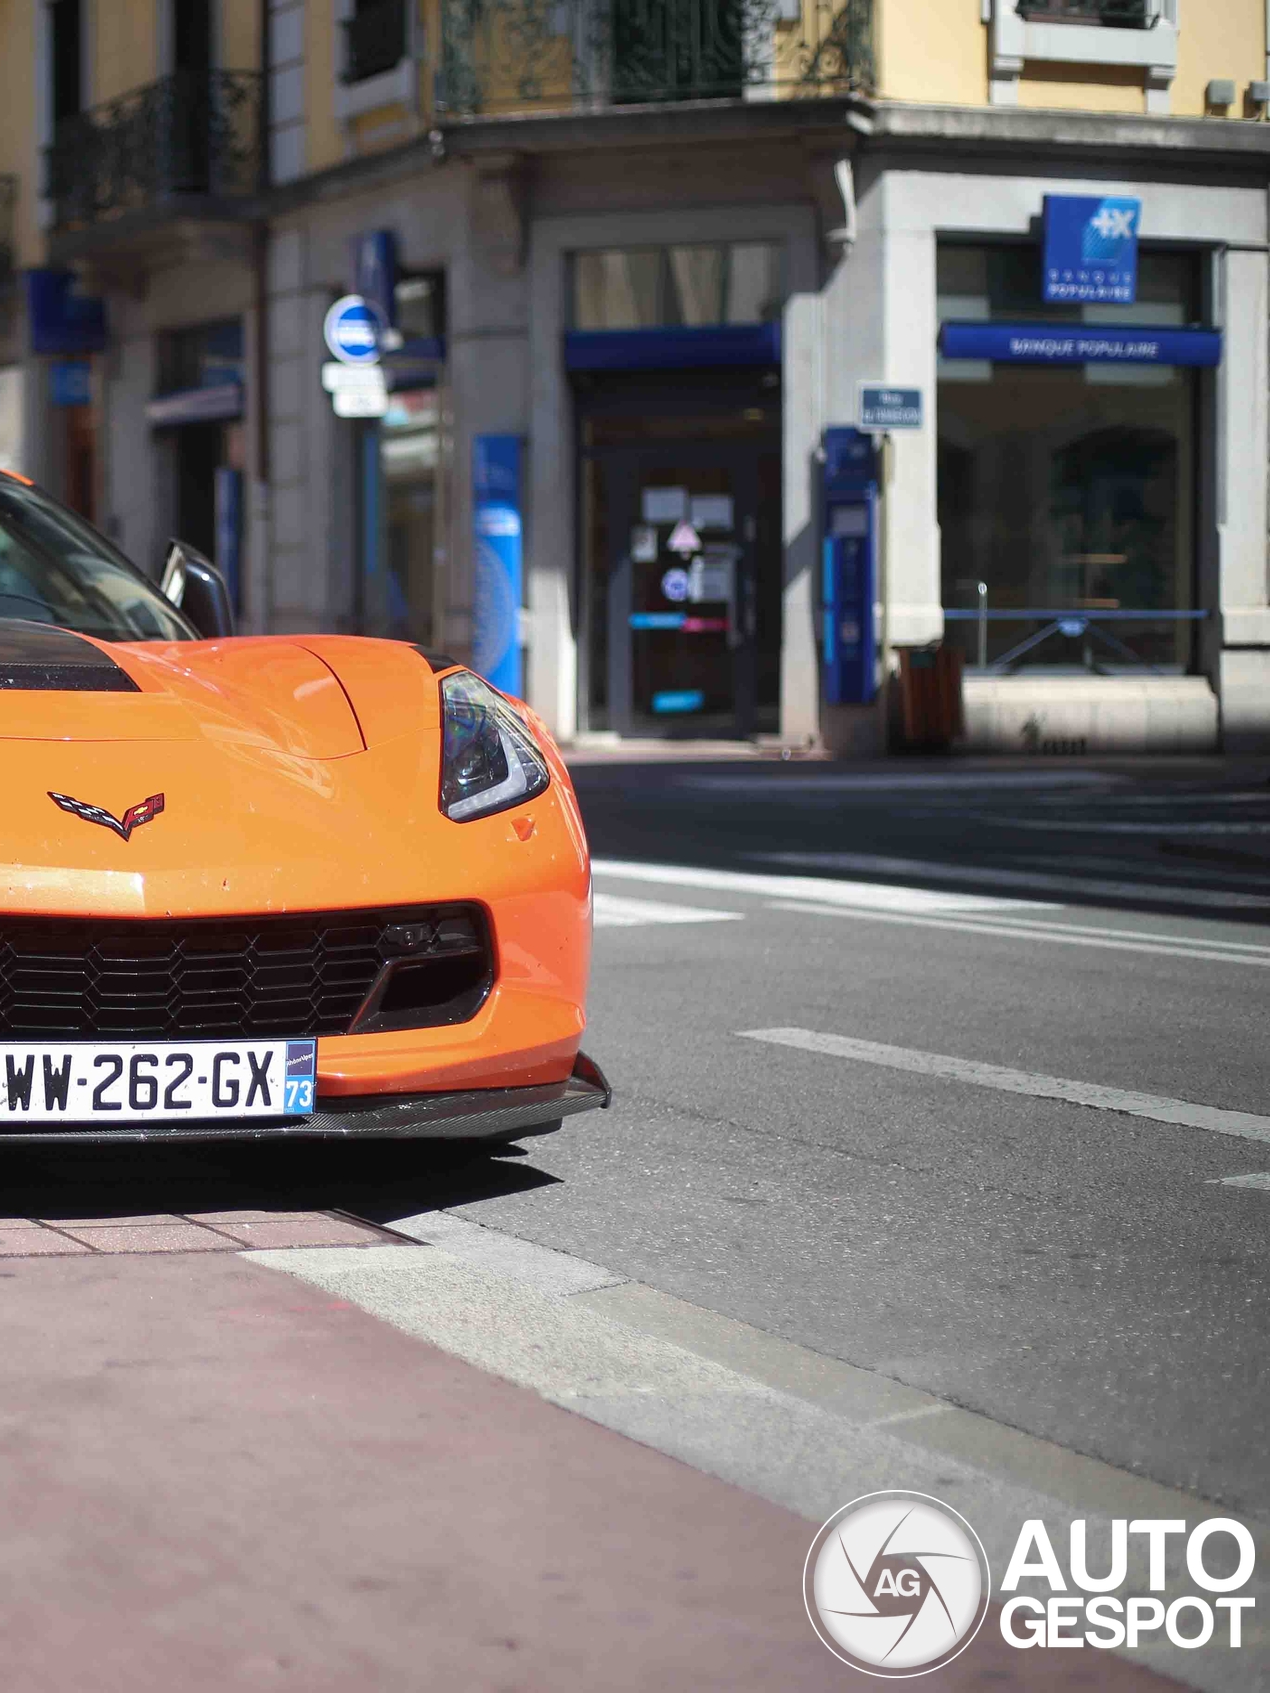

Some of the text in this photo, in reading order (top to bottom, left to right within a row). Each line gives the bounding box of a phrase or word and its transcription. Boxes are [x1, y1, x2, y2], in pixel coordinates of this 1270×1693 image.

[1048, 269, 1132, 283] BANQUE
[1048, 283, 1131, 299] POPULAIRE
[1010, 338, 1158, 359] BANQUE POPULAIRE
[4, 1050, 274, 1112] WW-262-GX
[286, 1080, 312, 1108] 73
